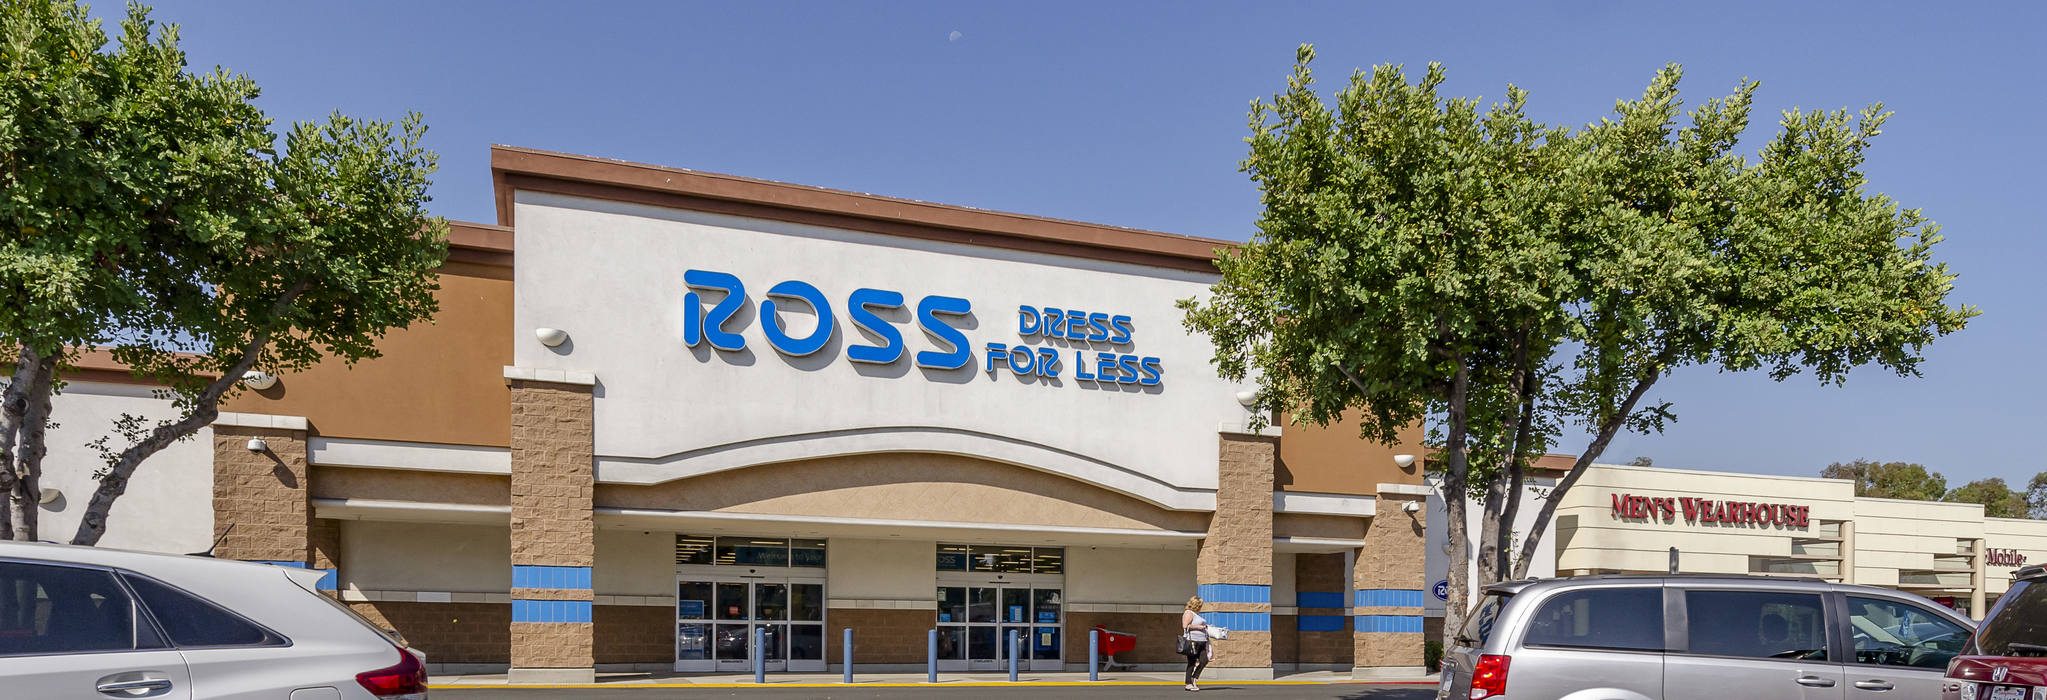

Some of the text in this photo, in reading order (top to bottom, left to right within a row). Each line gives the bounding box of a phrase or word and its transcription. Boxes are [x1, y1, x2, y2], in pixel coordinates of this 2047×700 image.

[683, 269, 972, 370] ROSS
[1018, 305, 1132, 344] DRESS
[985, 342, 1161, 386] FOR LESS
[1611, 493, 1810, 527] MEN'S WEARHOUSE
